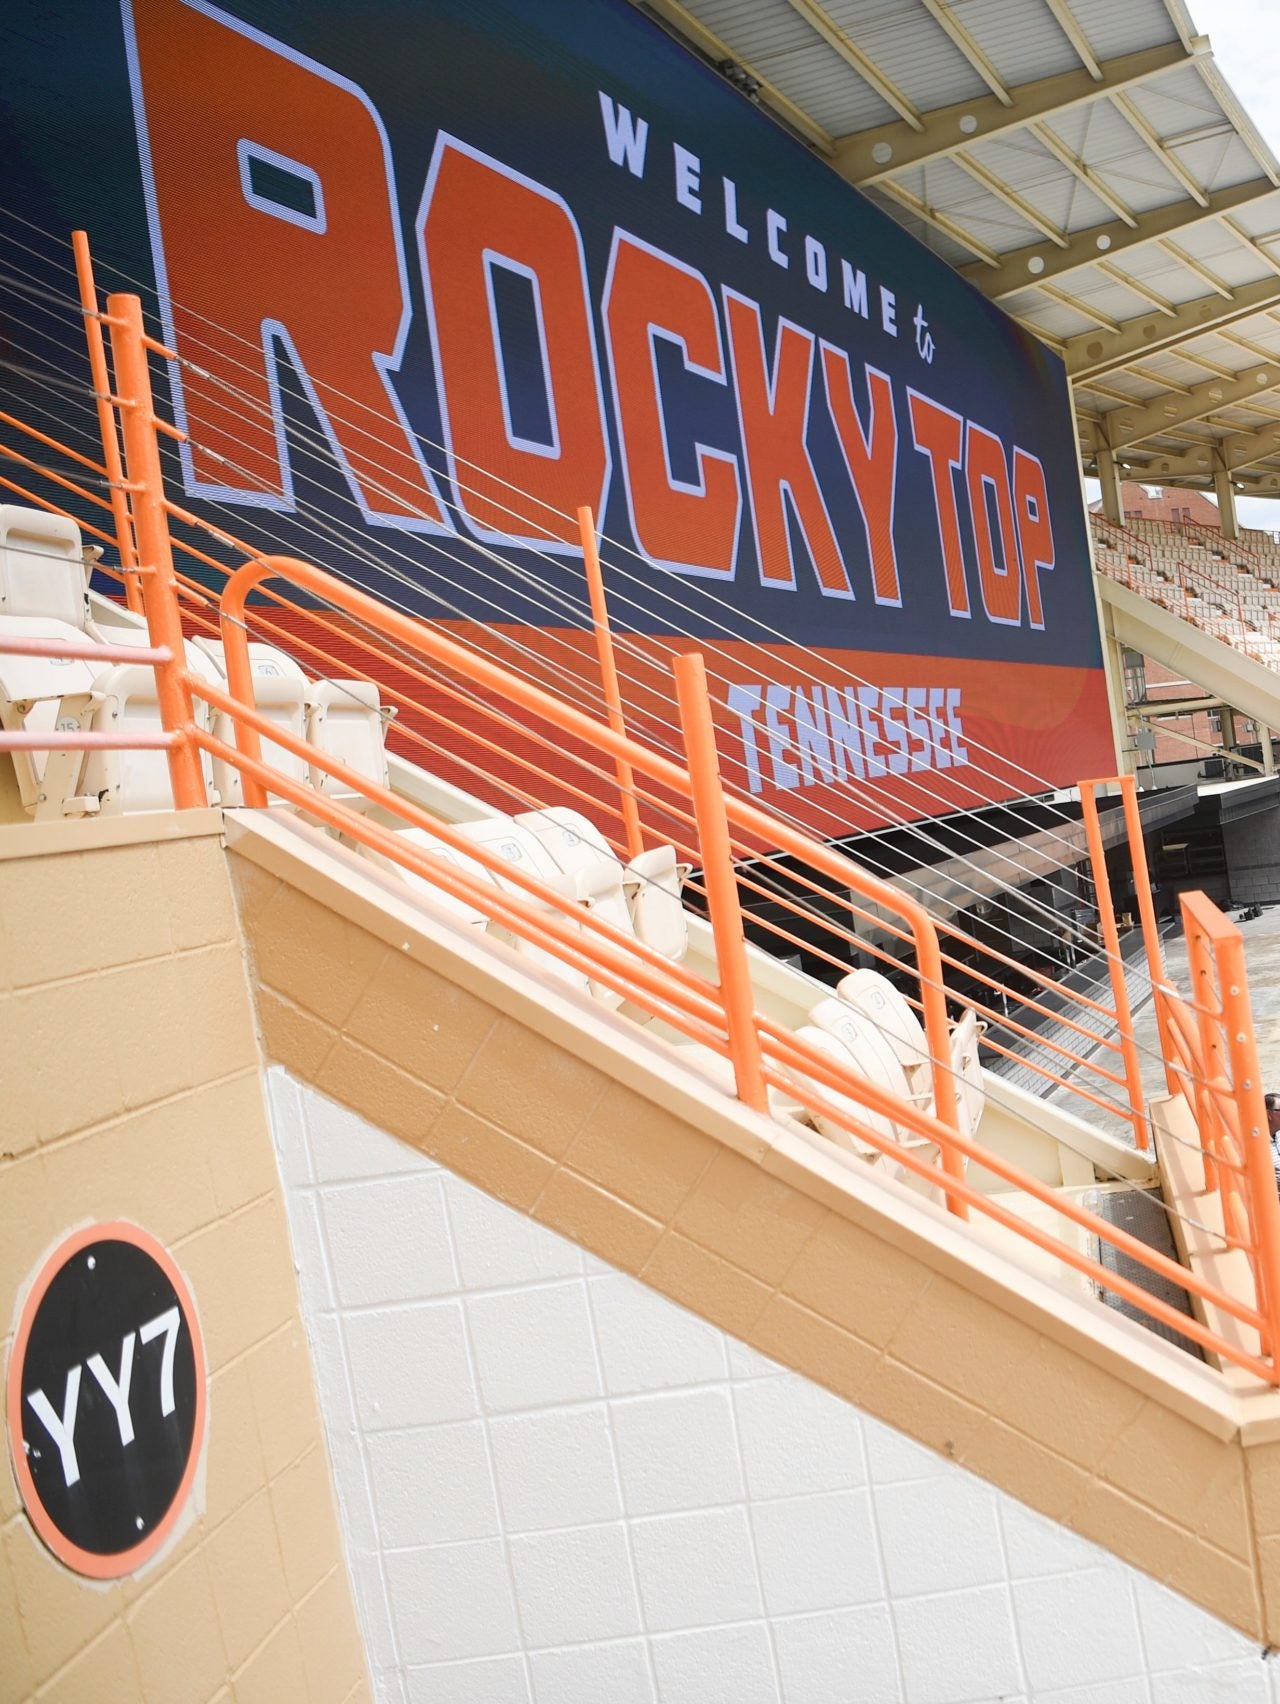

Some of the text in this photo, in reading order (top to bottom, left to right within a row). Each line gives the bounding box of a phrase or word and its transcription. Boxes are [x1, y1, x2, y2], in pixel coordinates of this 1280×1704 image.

[120, 0, 1055, 632] ROCKY TOP
[598, 90, 936, 364] WELCOME to
[727, 684, 968, 794] TENNESSEE
[27, 1305, 180, 1487] YY7
